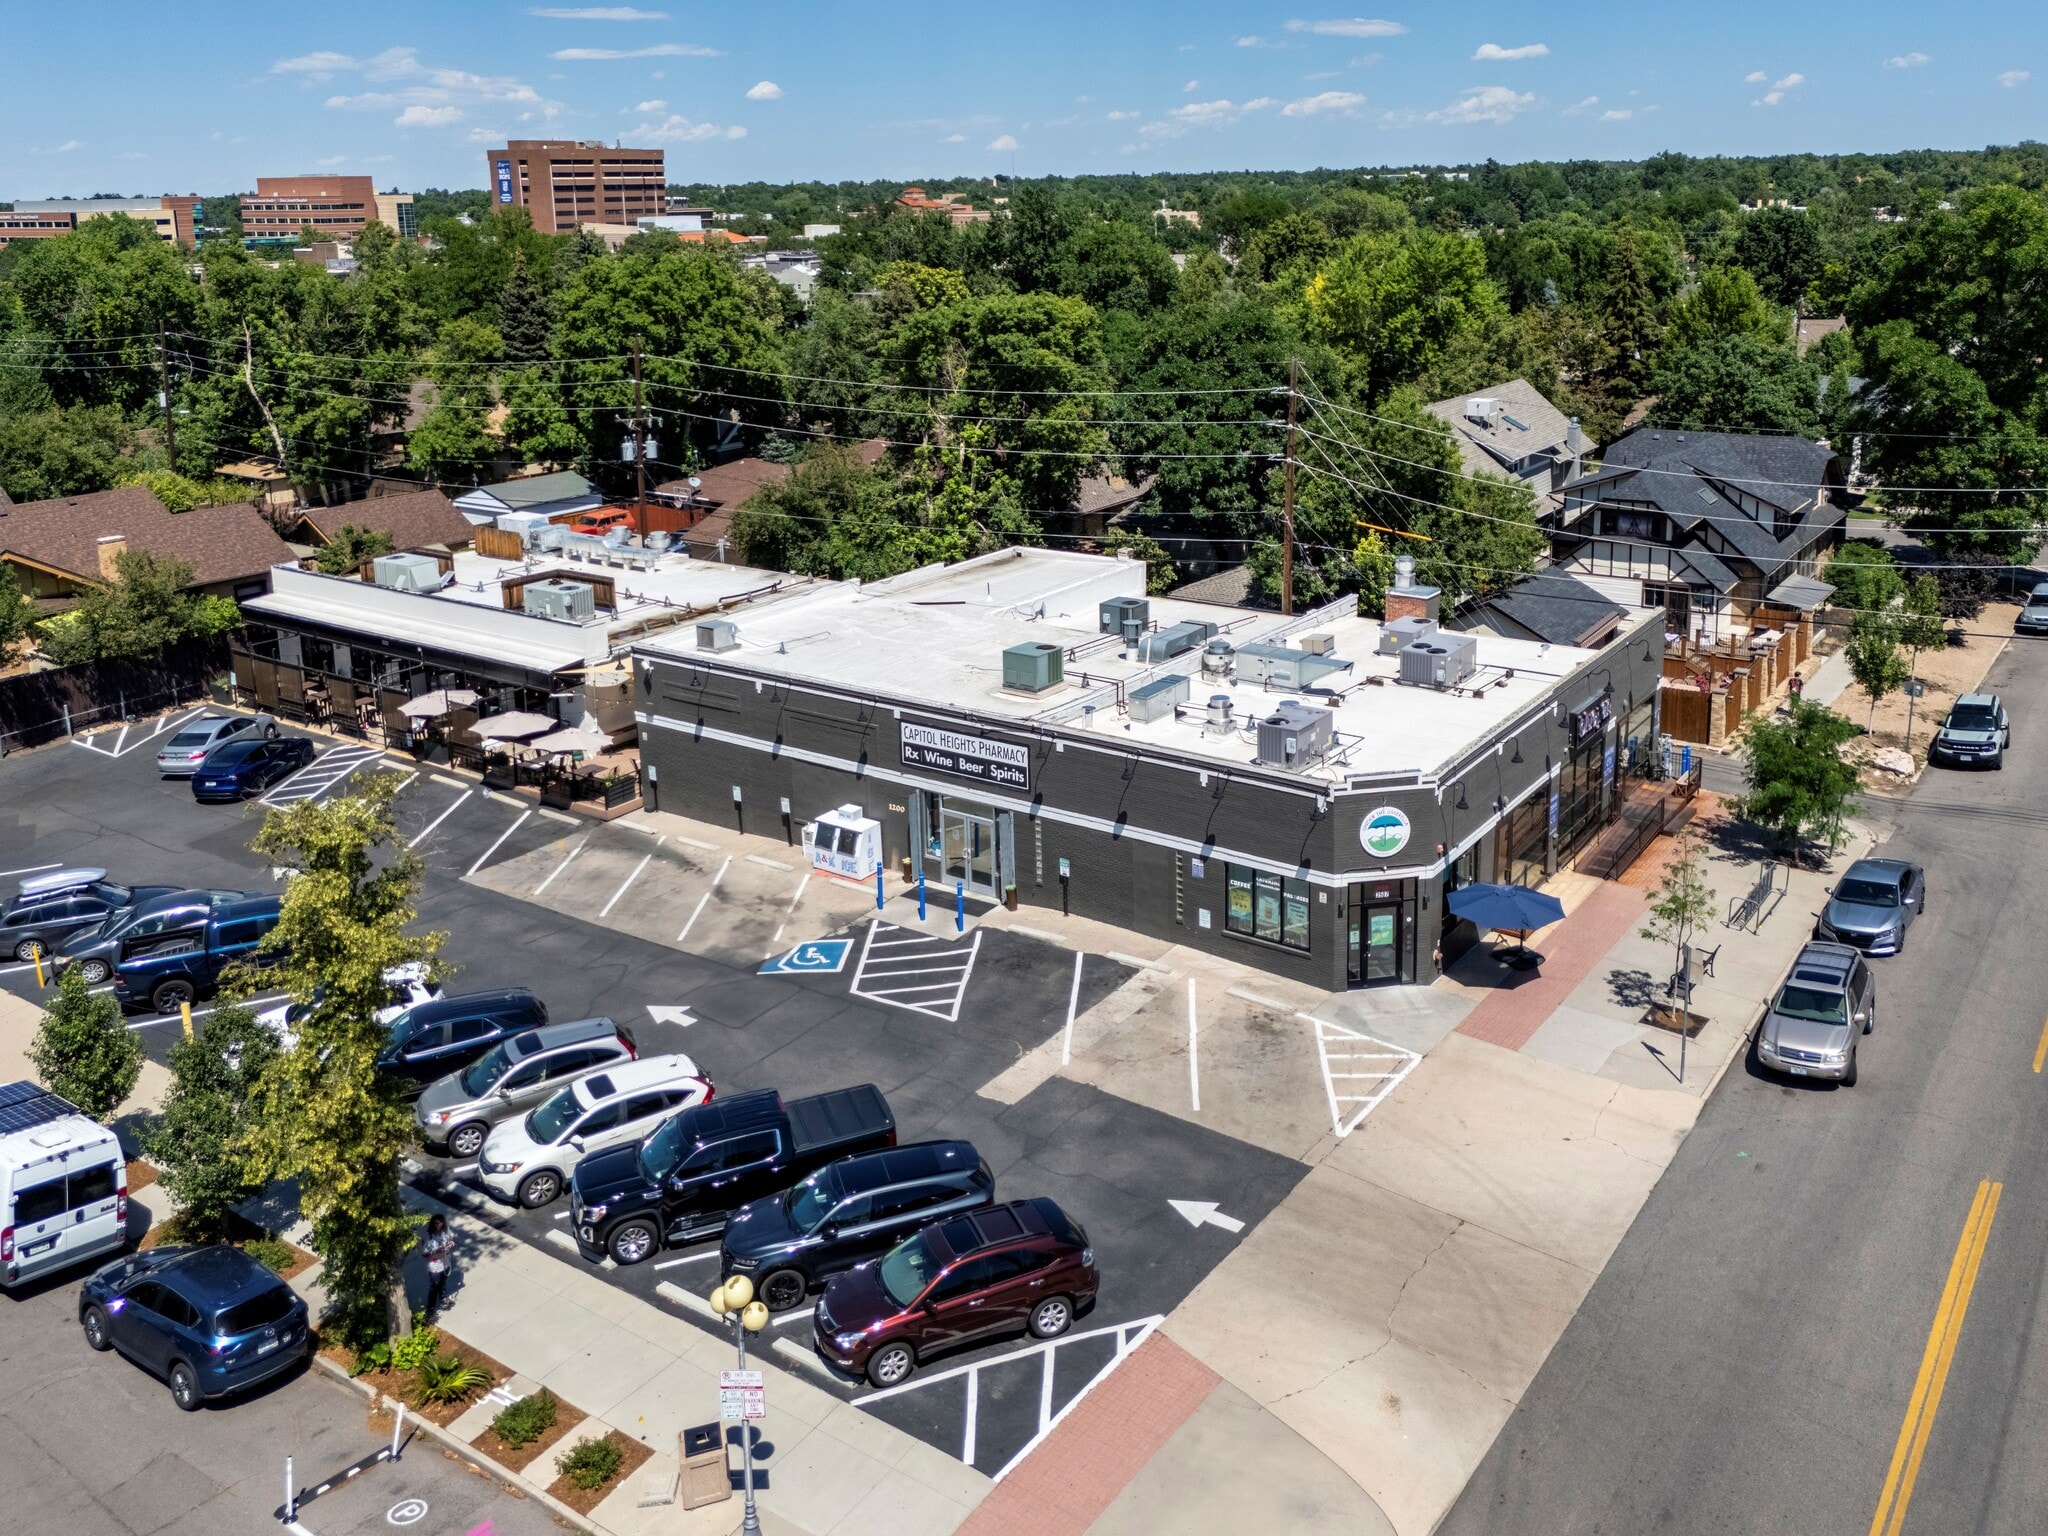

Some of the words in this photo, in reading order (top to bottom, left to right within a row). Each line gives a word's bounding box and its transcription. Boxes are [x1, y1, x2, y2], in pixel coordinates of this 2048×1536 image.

[903, 725, 937, 745] CAPITOL
[940, 733, 976, 754] HEIGHTS
[979, 741, 1026, 763] PHARMACY
[905, 746, 919, 760] Rx
[924, 750, 953, 767] Wine
[959, 757, 984, 774] Beer
[990, 764, 1025, 783] Spirits
[888, 803, 905, 813] 1200
[815, 852, 836, 868] A&K
[841, 858, 858, 874] ICE
[1230, 879, 1251, 889] COFFEE
